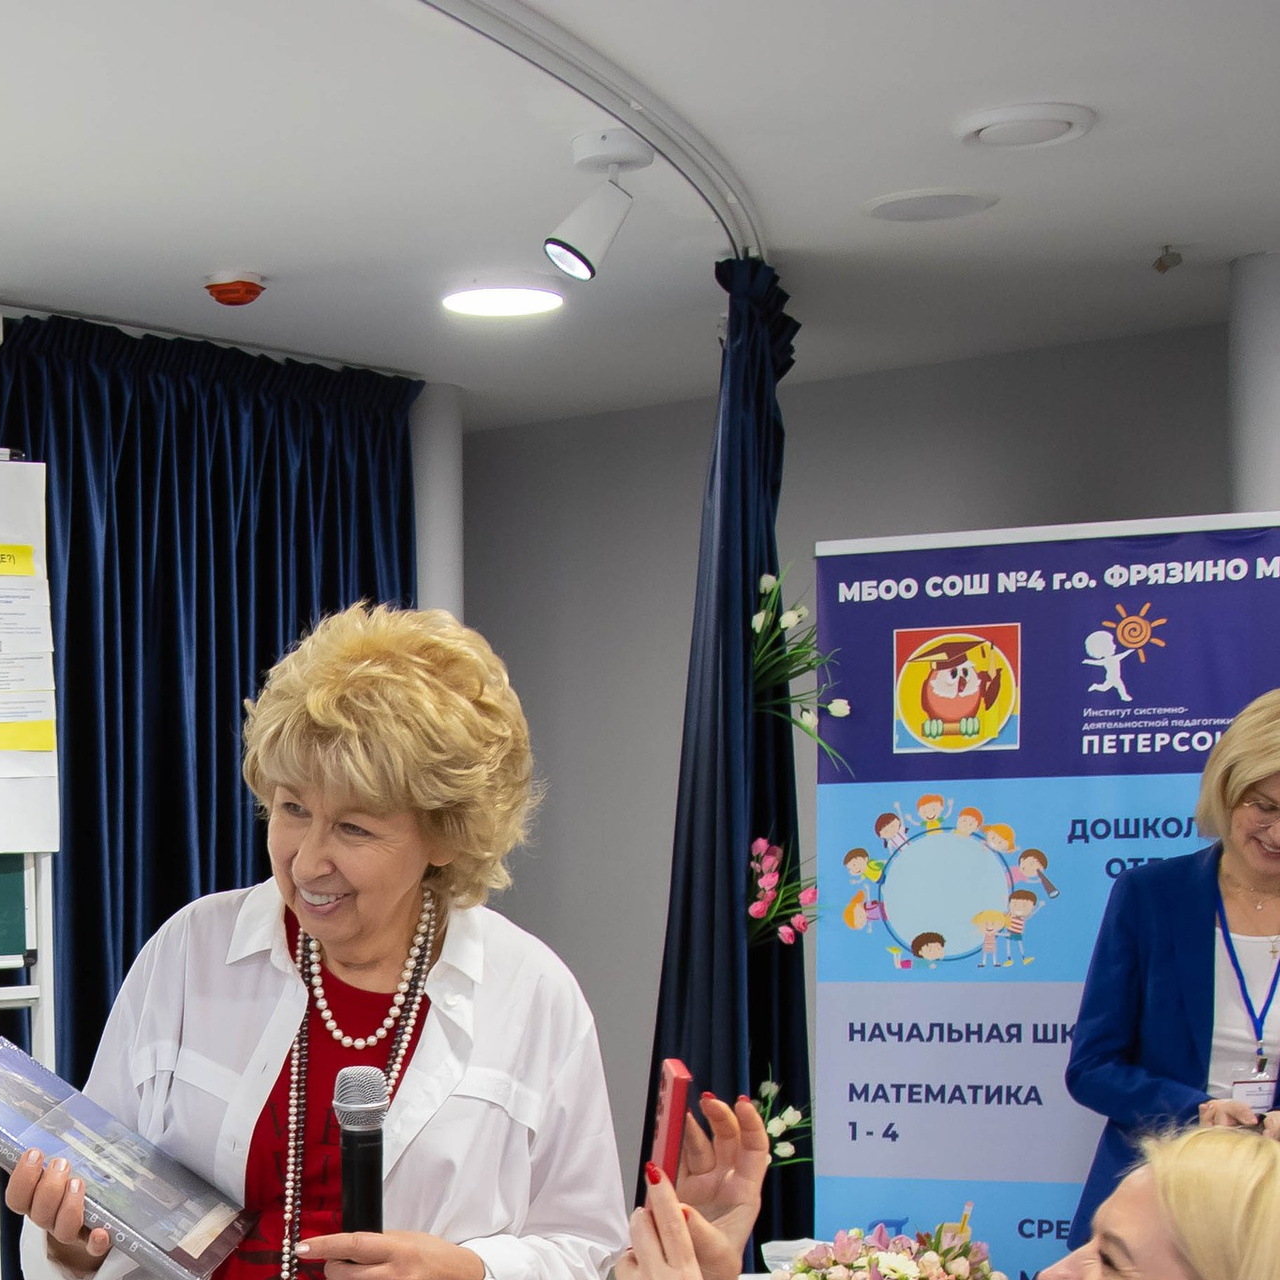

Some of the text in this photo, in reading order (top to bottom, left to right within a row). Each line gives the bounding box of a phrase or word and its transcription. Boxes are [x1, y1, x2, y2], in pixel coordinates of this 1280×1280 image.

[838, 578, 918, 603] МБОО
[925, 573, 989, 598] СОШ
[998, 569, 1045, 594] №4
[1052, 572, 1097, 591] г.о.
[1104, 557, 1248, 587] ФРЯЗИНО
[1083, 706, 1189, 718] Институт системно-
[1082, 718, 1234, 731] деятельностной педагогики
[848, 1022, 1022, 1043] НАЧАЛЬНАЯ
[848, 1083, 1043, 1106] МАТЕМАТИКА
[848, 1121, 857, 1141] 1
[882, 1122, 899, 1142] 4
